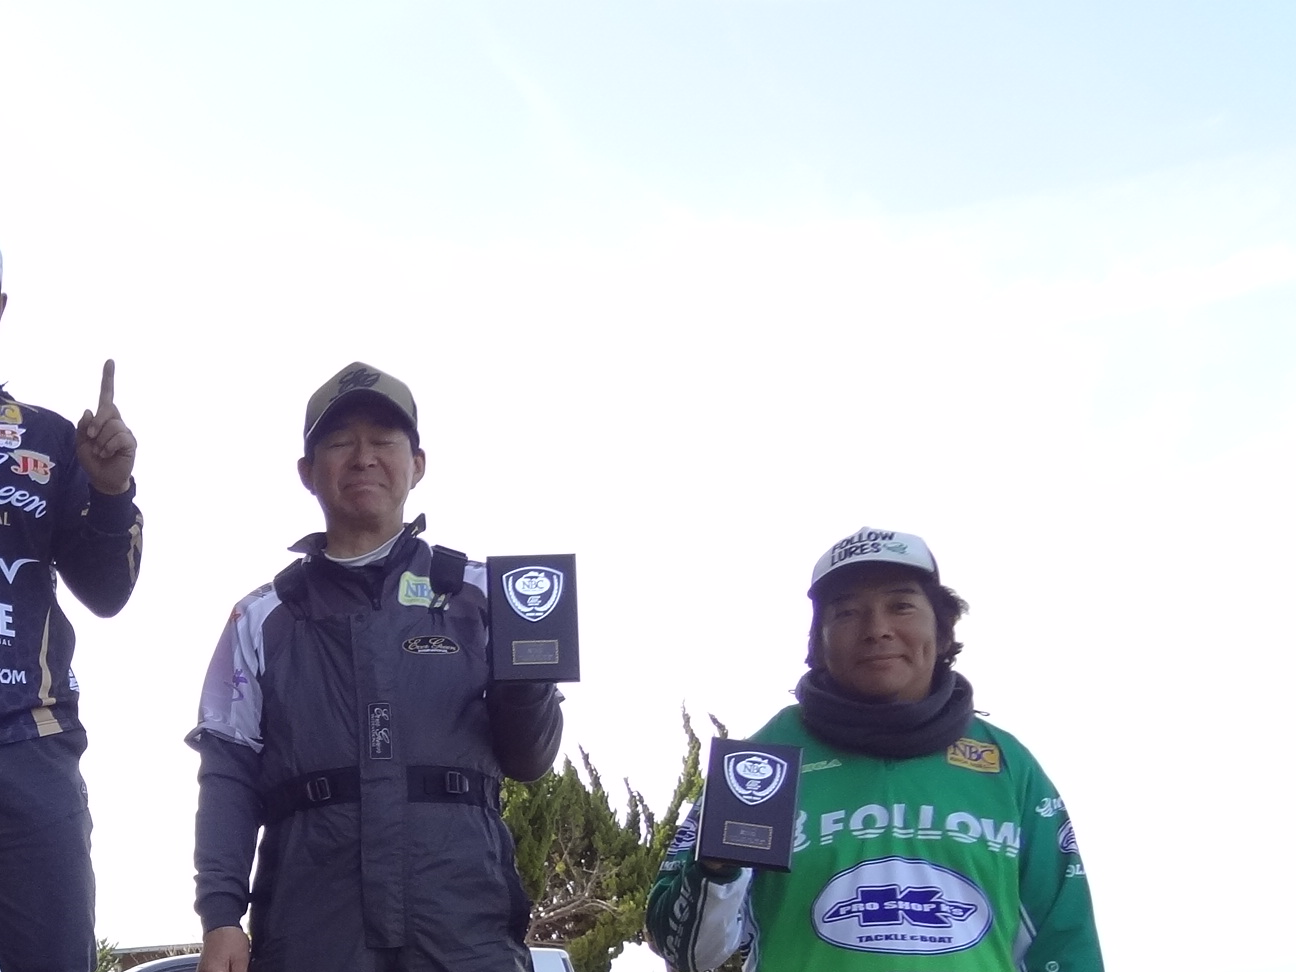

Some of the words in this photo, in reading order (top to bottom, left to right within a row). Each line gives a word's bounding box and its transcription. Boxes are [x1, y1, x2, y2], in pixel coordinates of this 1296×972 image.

[831, 530, 895, 554] FOLLOW
[830, 542, 882, 566] LURES
[522, 580, 545, 590] NBC
[951, 743, 996, 765] NBC
[742, 764, 767, 775] NBC
[820, 804, 1021, 857] FOLLOW
[838, 902, 880, 915] PRO
[884, 901, 937, 912] SHOP
[857, 934, 908, 943] TACKLE
[920, 935, 954, 943] BOAT
